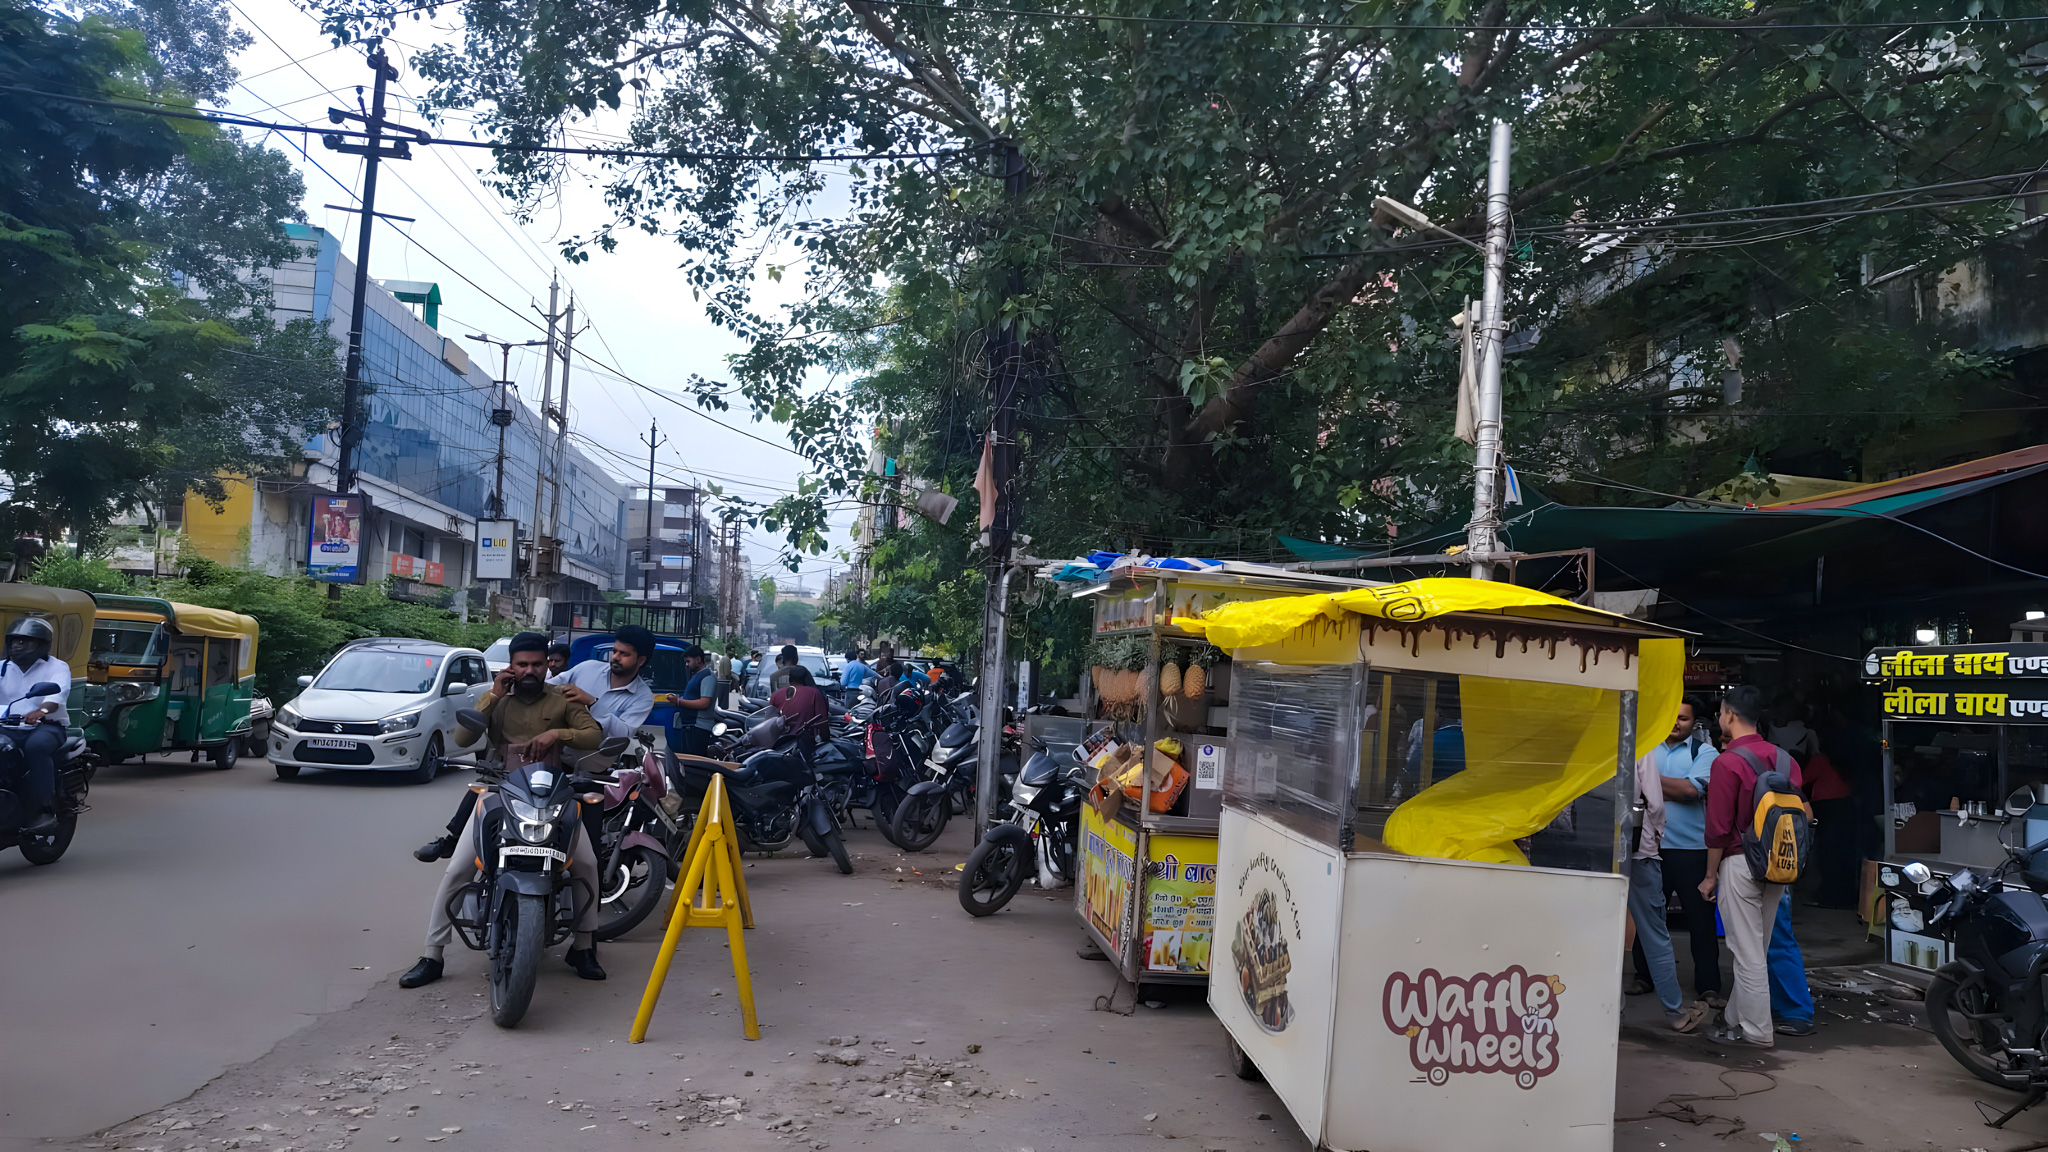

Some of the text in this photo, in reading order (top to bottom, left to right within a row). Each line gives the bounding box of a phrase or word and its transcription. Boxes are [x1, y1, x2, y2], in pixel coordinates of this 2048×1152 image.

[1881, 650, 1949, 676] लीला
[1953, 652, 2009, 675] चाय
[1883, 686, 1949, 715] लीला
[1954, 693, 2009, 717] चाय
[1389, 971, 1552, 1033] Waffle
